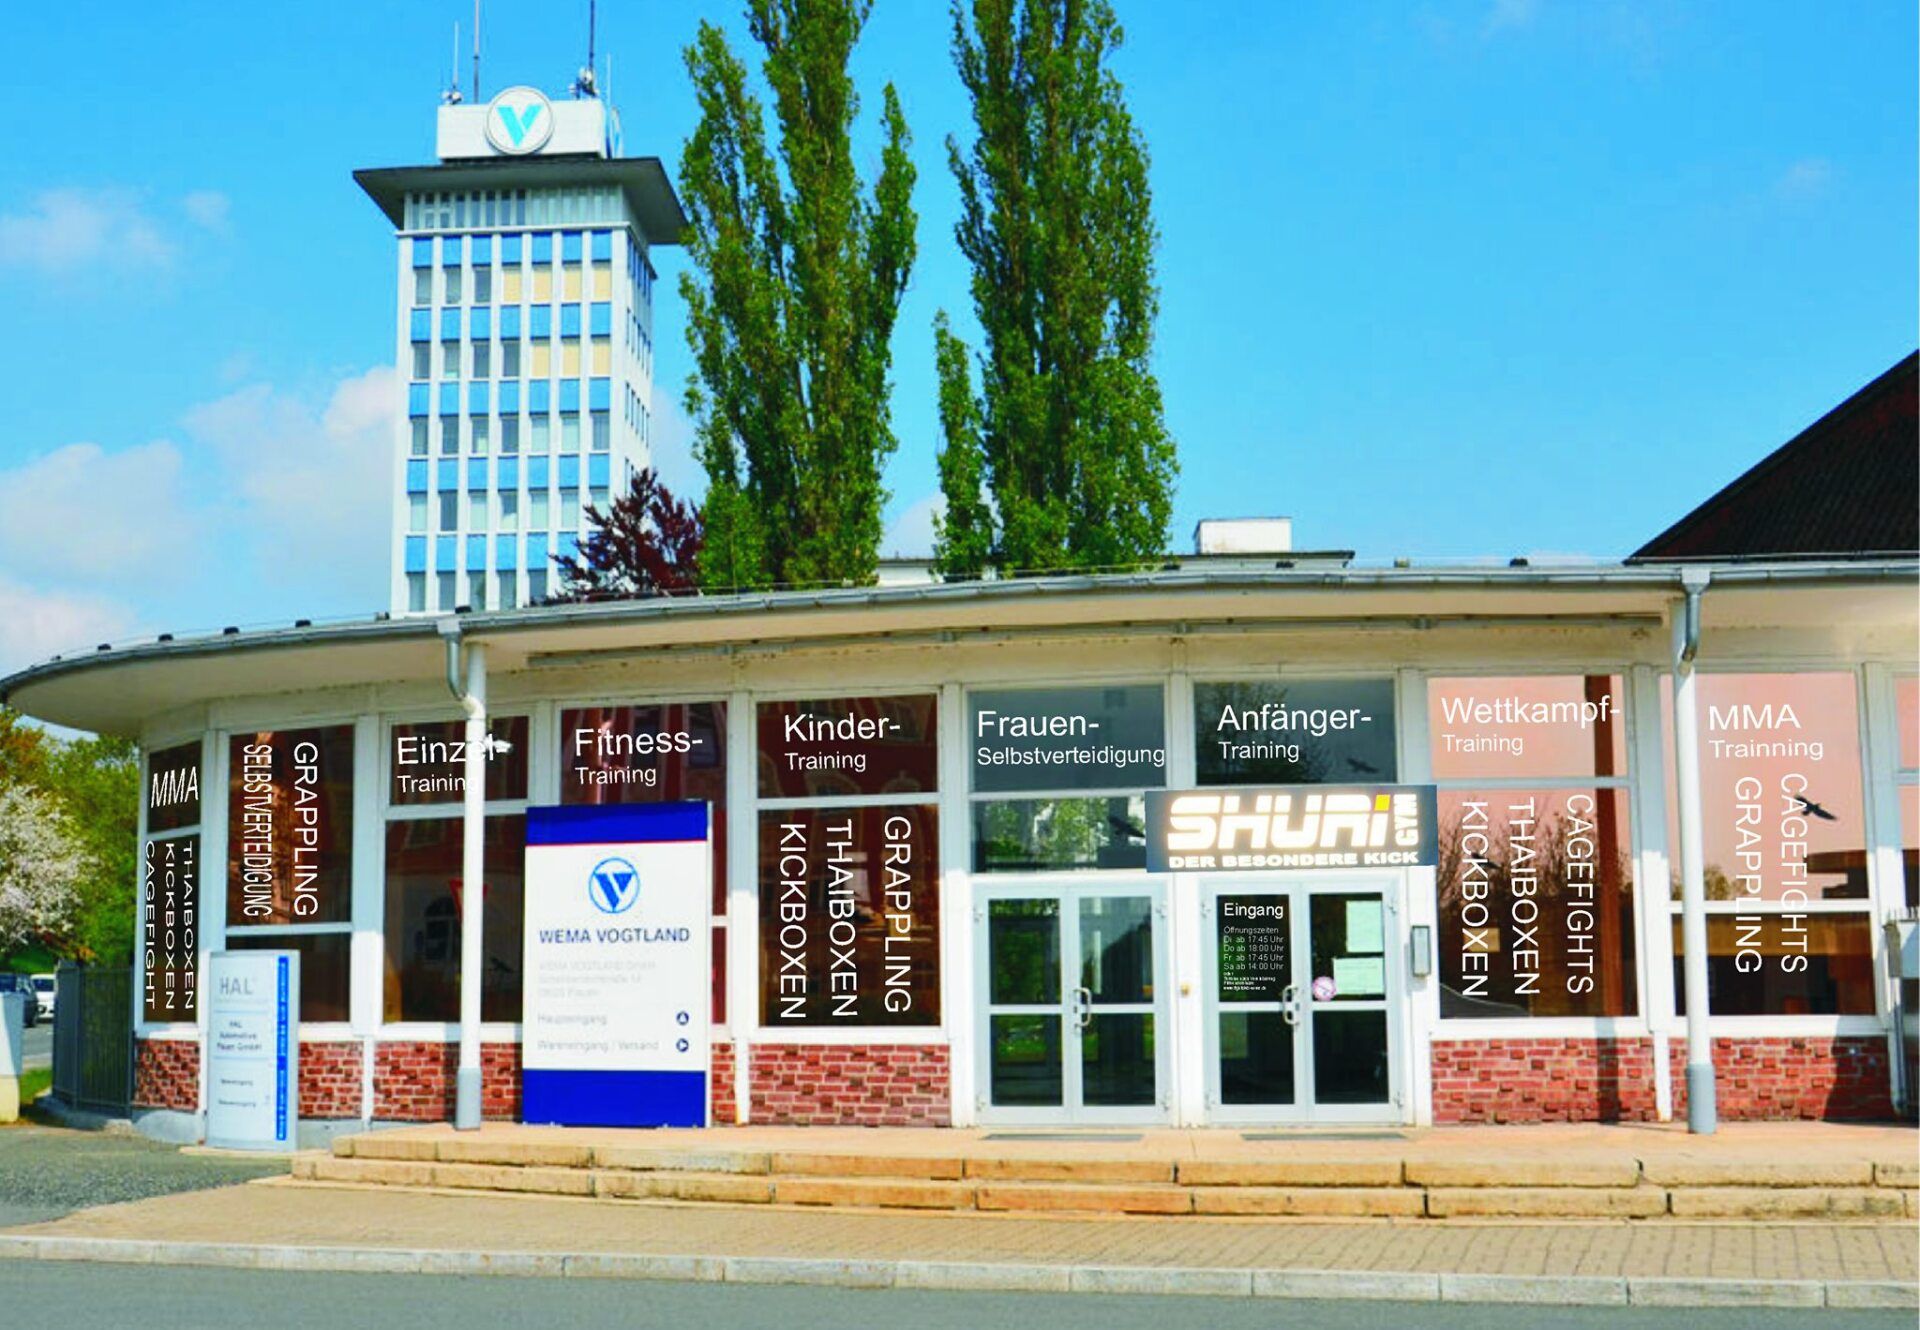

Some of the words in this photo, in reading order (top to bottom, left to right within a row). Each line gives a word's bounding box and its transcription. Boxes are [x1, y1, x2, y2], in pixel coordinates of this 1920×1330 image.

[977, 710, 1099, 738] Frauen-
[1217, 704, 1372, 736] Anfänger-
[1441, 695, 1621, 728] Wettkampf-
[1709, 704, 1801, 730] MMA
[784, 712, 900, 742] Kinder-
[575, 728, 703, 757] Fitness-
[977, 746, 1166, 768] Selbstverteidigung
[1218, 741, 1300, 763] Training
[1442, 733, 1524, 756] Training
[1709, 739, 1824, 761] Trainning
[575, 766, 657, 787] Training
[784, 751, 867, 773] Training
[151, 766, 198, 808] MMA
[243, 744, 272, 917] SELBSTVERTEIDIGUNG
[293, 741, 319, 916] GRAPPLING
[1393, 793, 1420, 847] GYM
[1168, 856, 1216, 869] DER
[1222, 853, 1358, 868] BESONDERE
[1364, 852, 1420, 865] KICK
[1734, 776, 1762, 973] GRAPPLING
[1780, 773, 1808, 973] CAGEFIGHTS
[1461, 802, 1489, 997] KICKBOXEN
[1508, 797, 1540, 995] THAIBOXEN
[1566, 794, 1594, 994] CAGEFIGHTS
[145, 840, 155, 1010] CAGEFIGHT
[183, 841, 194, 1009] THAIBOXEN
[779, 824, 807, 1018] KICKBOXEN
[826, 819, 858, 1017] THAIBOXEN
[884, 816, 912, 1013] GRAPPLING
[1224, 902, 1284, 919] Eingang
[165, 843, 175, 1009] KICKBOXEN
[539, 929, 592, 944] WEMA
[596, 927, 690, 943] VOGTLAND
[1223, 926, 1279, 935] Öffnungszeiten
[1236, 935, 1246, 943] ab
[1270, 935, 1284, 943] Uhr
[1223, 944, 1235, 952] Do
[1236, 944, 1246, 952] ab
[1270, 944, 1284, 952] Uhr
[1223, 962, 1235, 970] Sa
[1236, 962, 1246, 970] ab
[1270, 962, 1284, 970] Uhr
[219, 977, 254, 995] HAL
